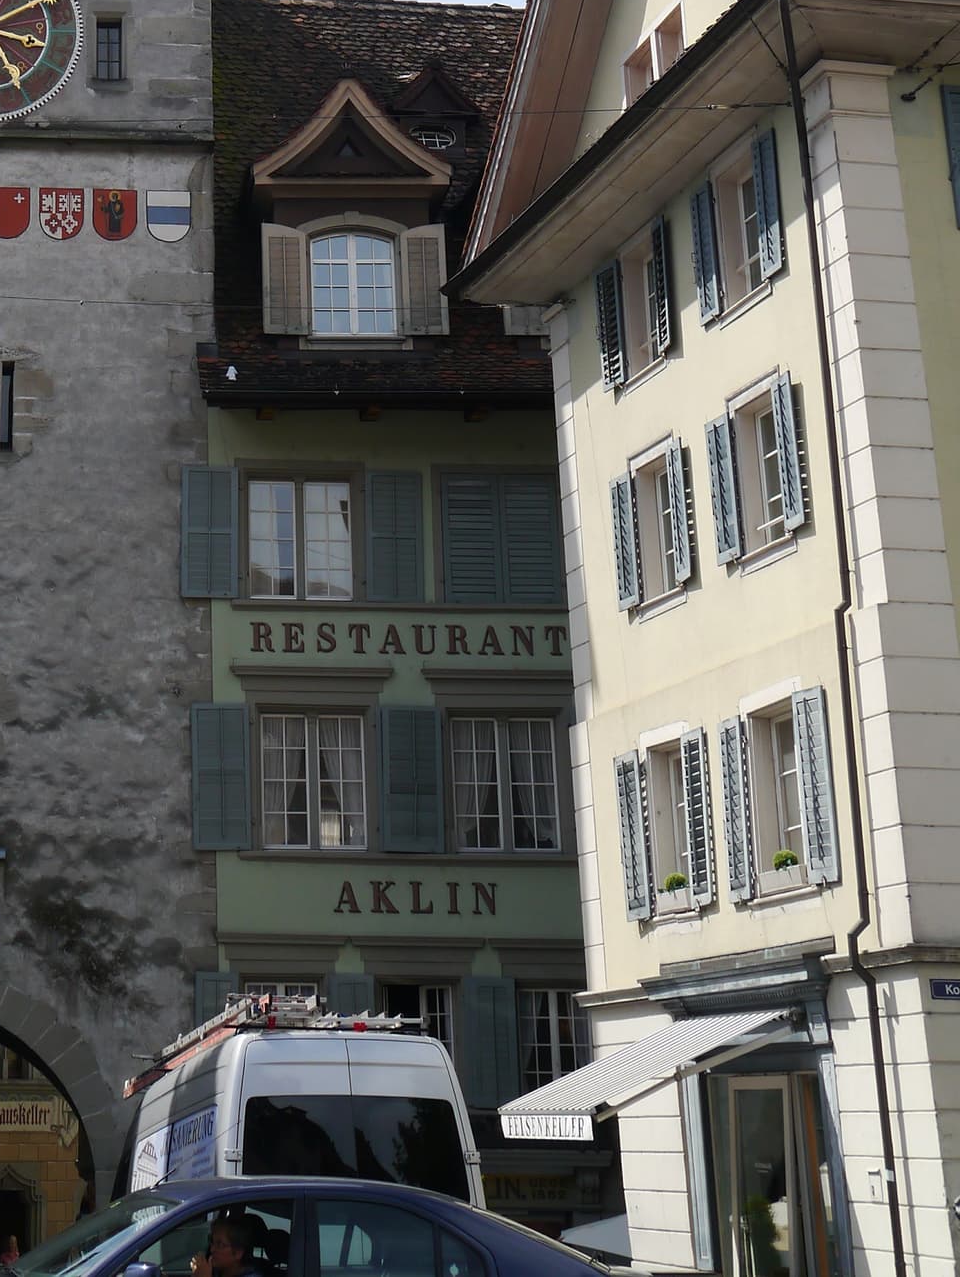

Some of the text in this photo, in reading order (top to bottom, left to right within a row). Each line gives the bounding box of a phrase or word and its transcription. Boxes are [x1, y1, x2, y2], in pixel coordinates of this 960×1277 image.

[249, 621, 567, 657] RESTAURANT
[333, 880, 498, 916] AKLIN
[507, 1116, 585, 1138] FELSENKELLER
